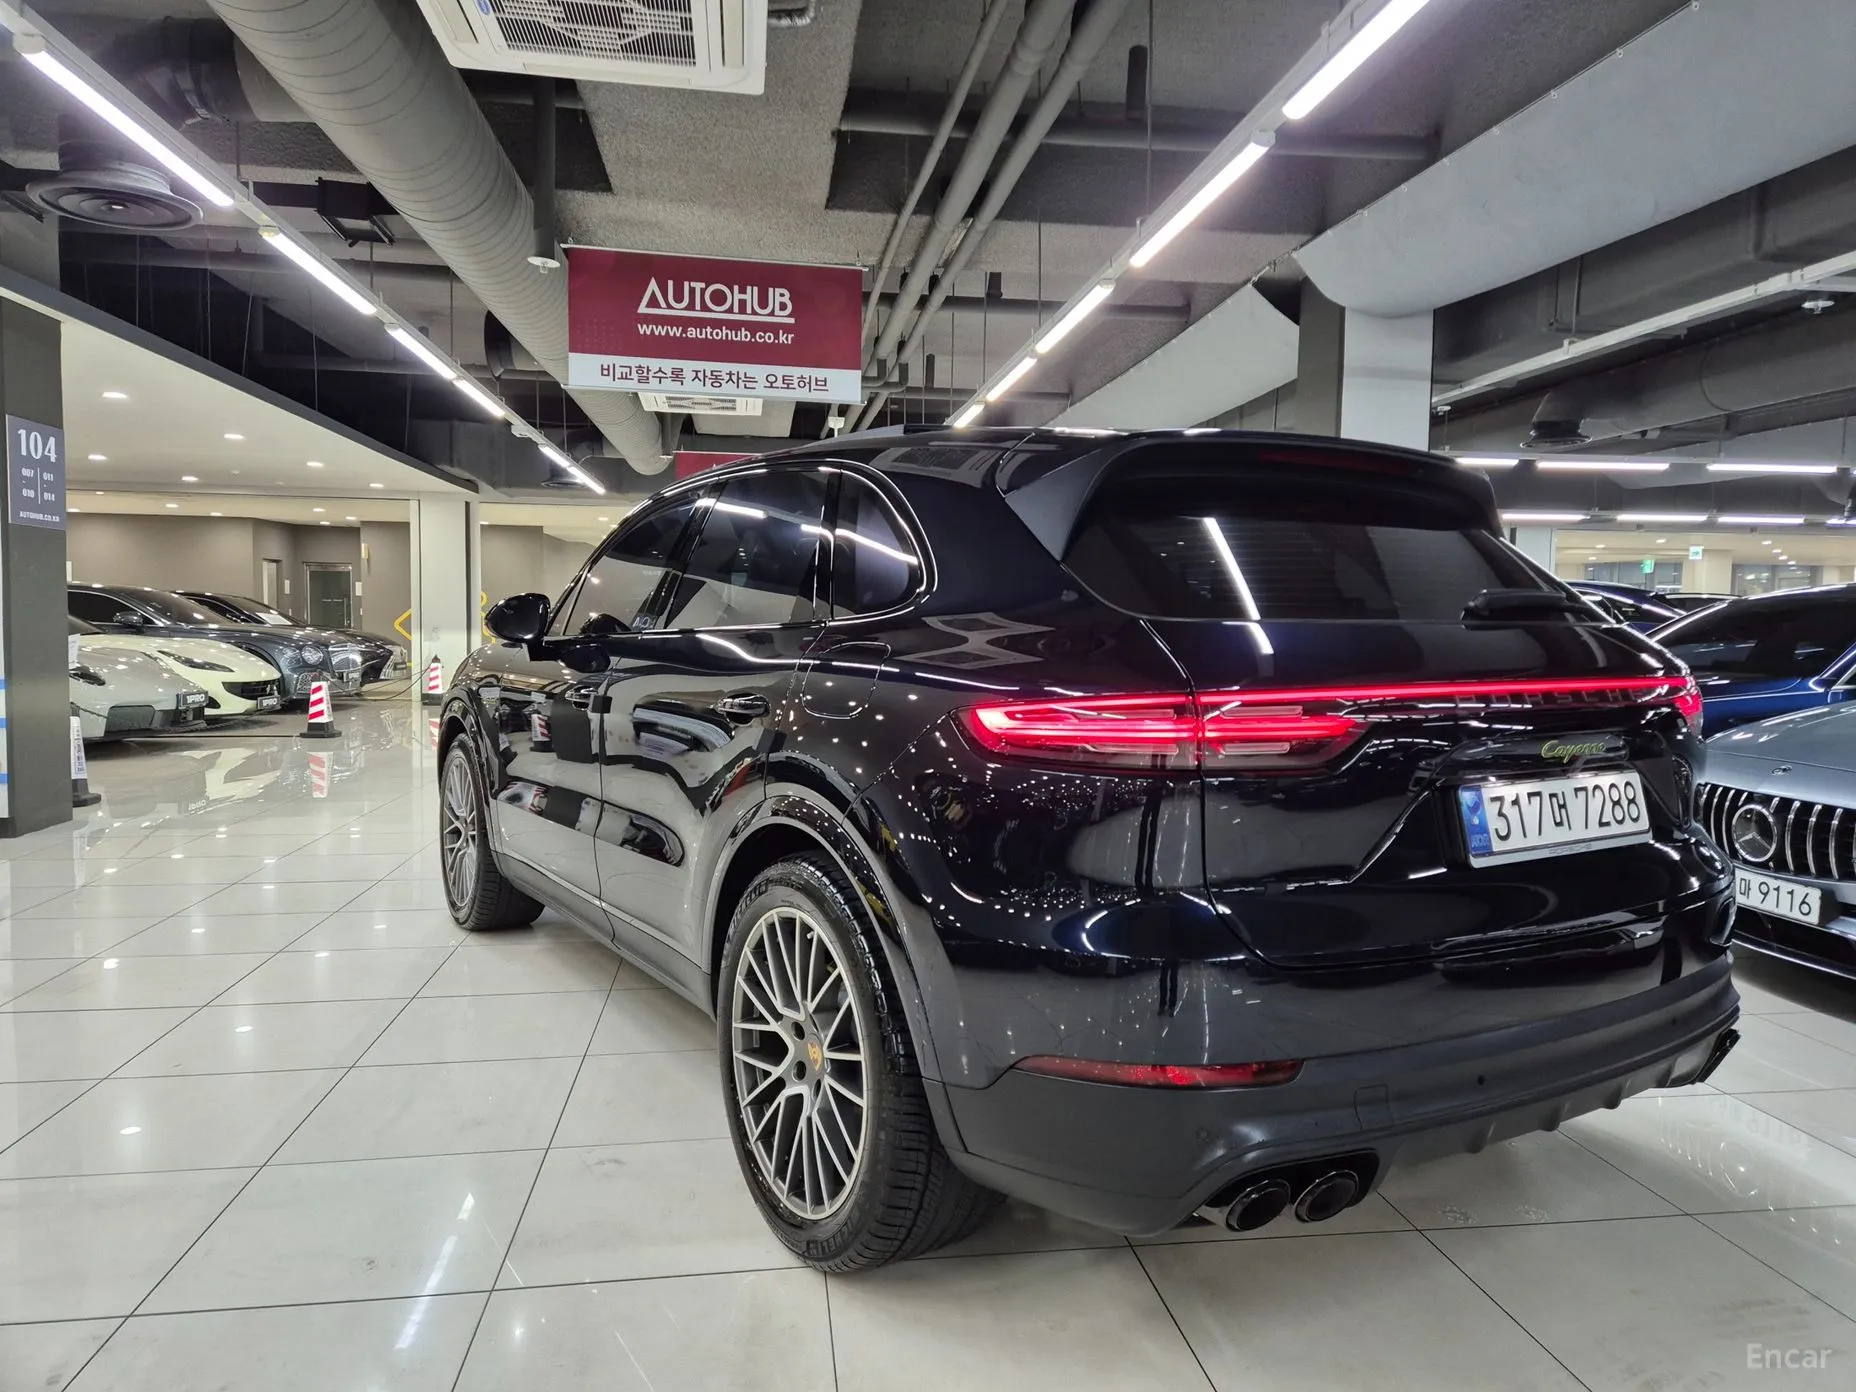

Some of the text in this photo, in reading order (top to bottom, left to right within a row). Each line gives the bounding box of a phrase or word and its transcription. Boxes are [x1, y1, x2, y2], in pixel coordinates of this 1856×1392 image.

[637, 277, 795, 323] AUTOHUB
[637, 322, 794, 345] www.autohub.co.kr
[600, 363, 829, 392] 비교할수록 자동차는 오토허브
[17, 428, 57, 463] 104
[21, 467, 34, 477] 007
[22, 488, 35, 498] 010
[1573, 781, 1640, 830] 7288
[1739, 878, 1811, 916] 마 9116
